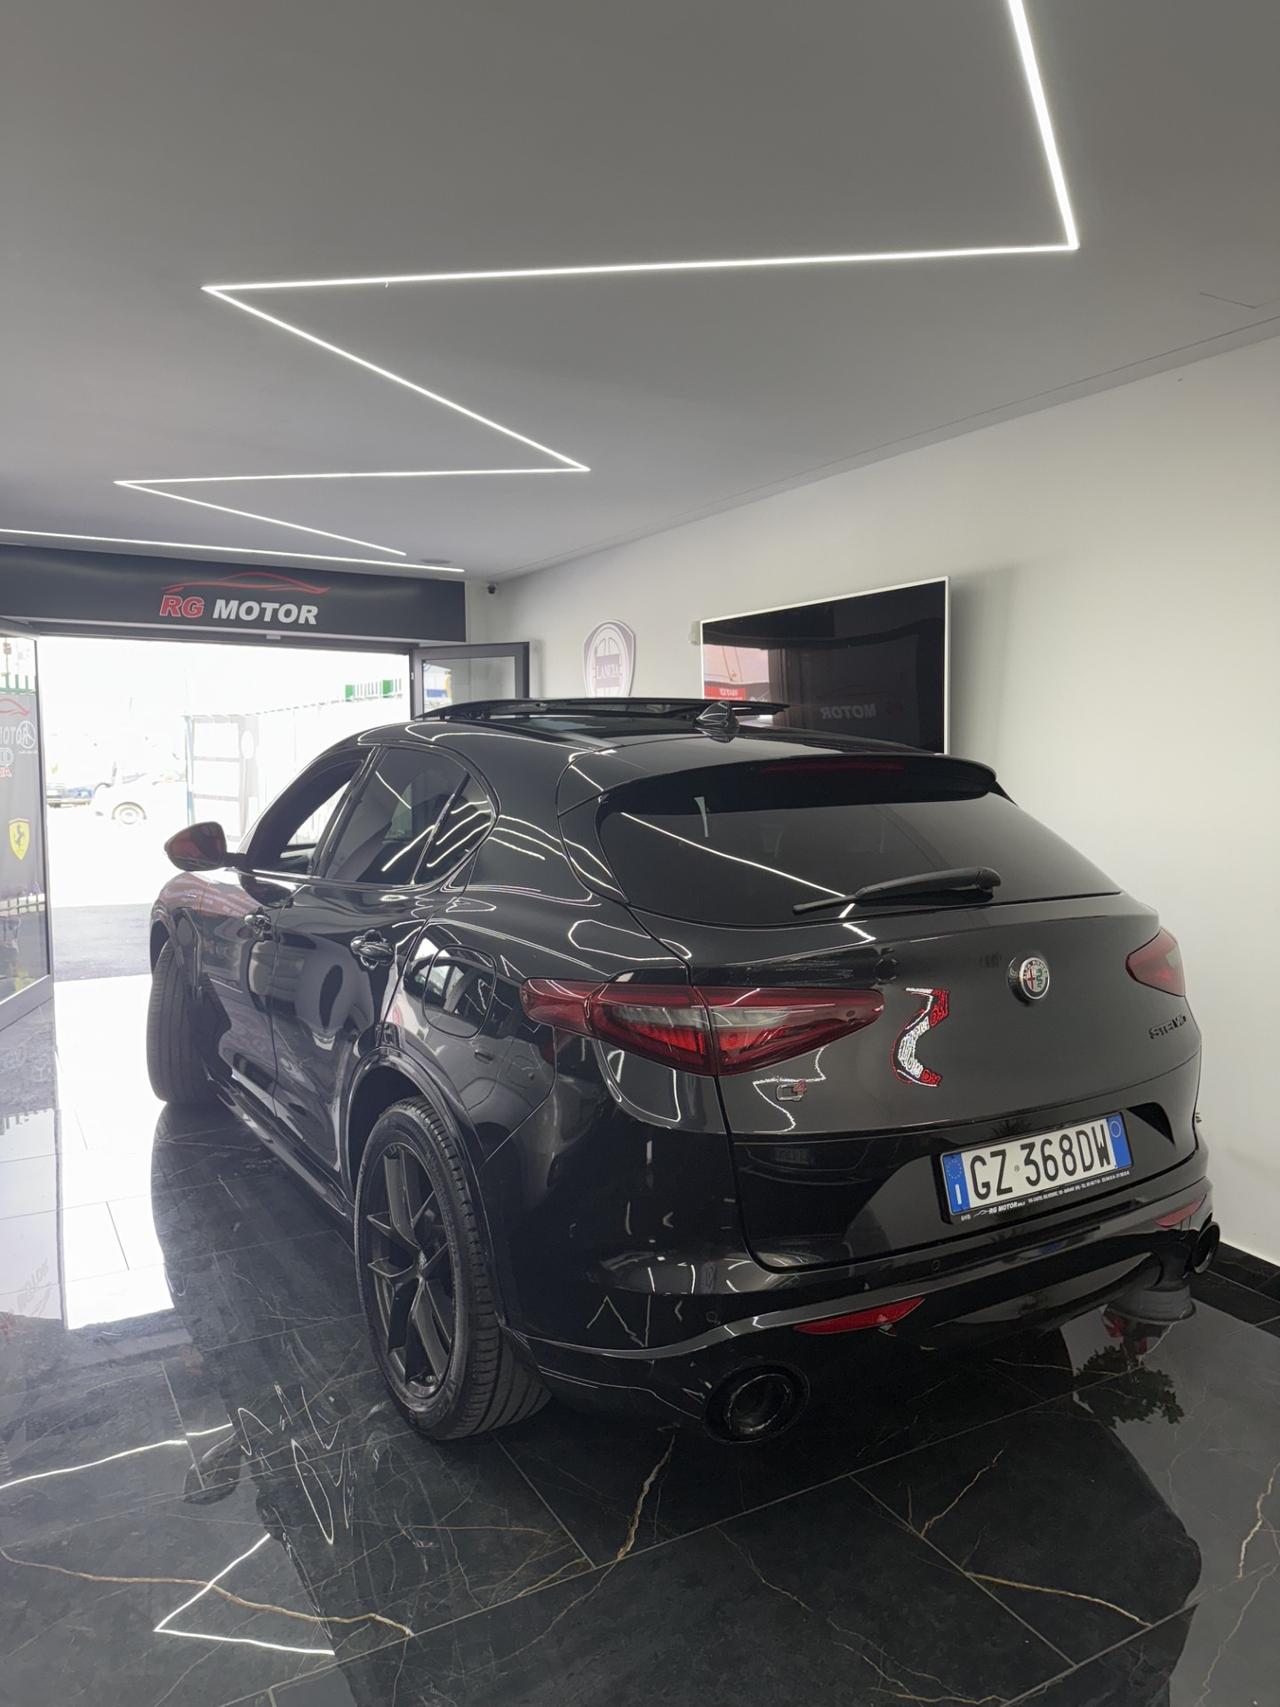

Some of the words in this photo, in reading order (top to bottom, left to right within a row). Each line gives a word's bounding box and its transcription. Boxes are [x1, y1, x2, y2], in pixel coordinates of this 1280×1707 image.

[159, 594, 205, 618] RG
[212, 599, 319, 624] MOTOR
[0, 726, 29, 745] OTOR
[969, 1148, 1014, 1201] GZ
[1020, 1124, 1111, 1187] 368DW
